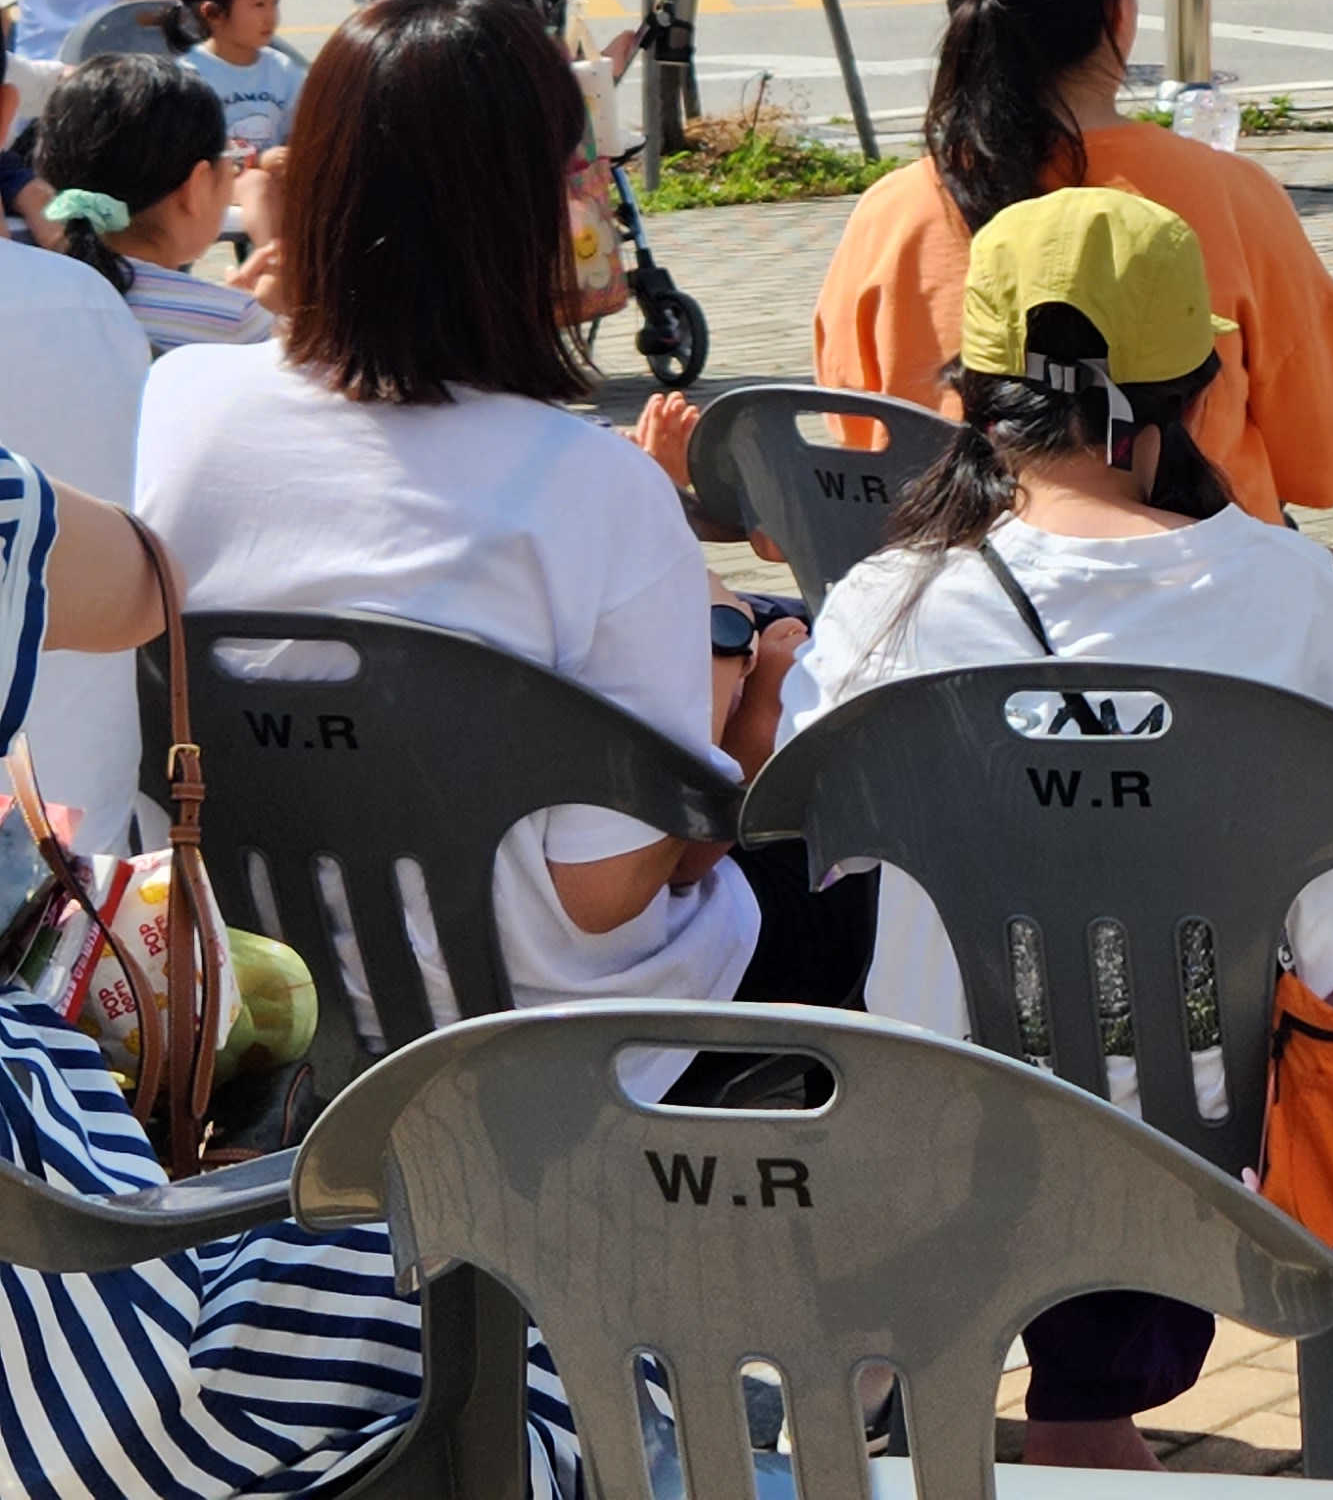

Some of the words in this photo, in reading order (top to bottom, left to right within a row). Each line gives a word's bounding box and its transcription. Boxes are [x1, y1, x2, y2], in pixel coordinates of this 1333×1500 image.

[813, 467, 890, 505] W.R
[244, 709, 359, 750] W.R
[1026, 767, 1153, 809] W.R
[139, 923, 163, 957] POP
[98, 987, 124, 1021] POP
[644, 1150, 813, 1208] W.R
